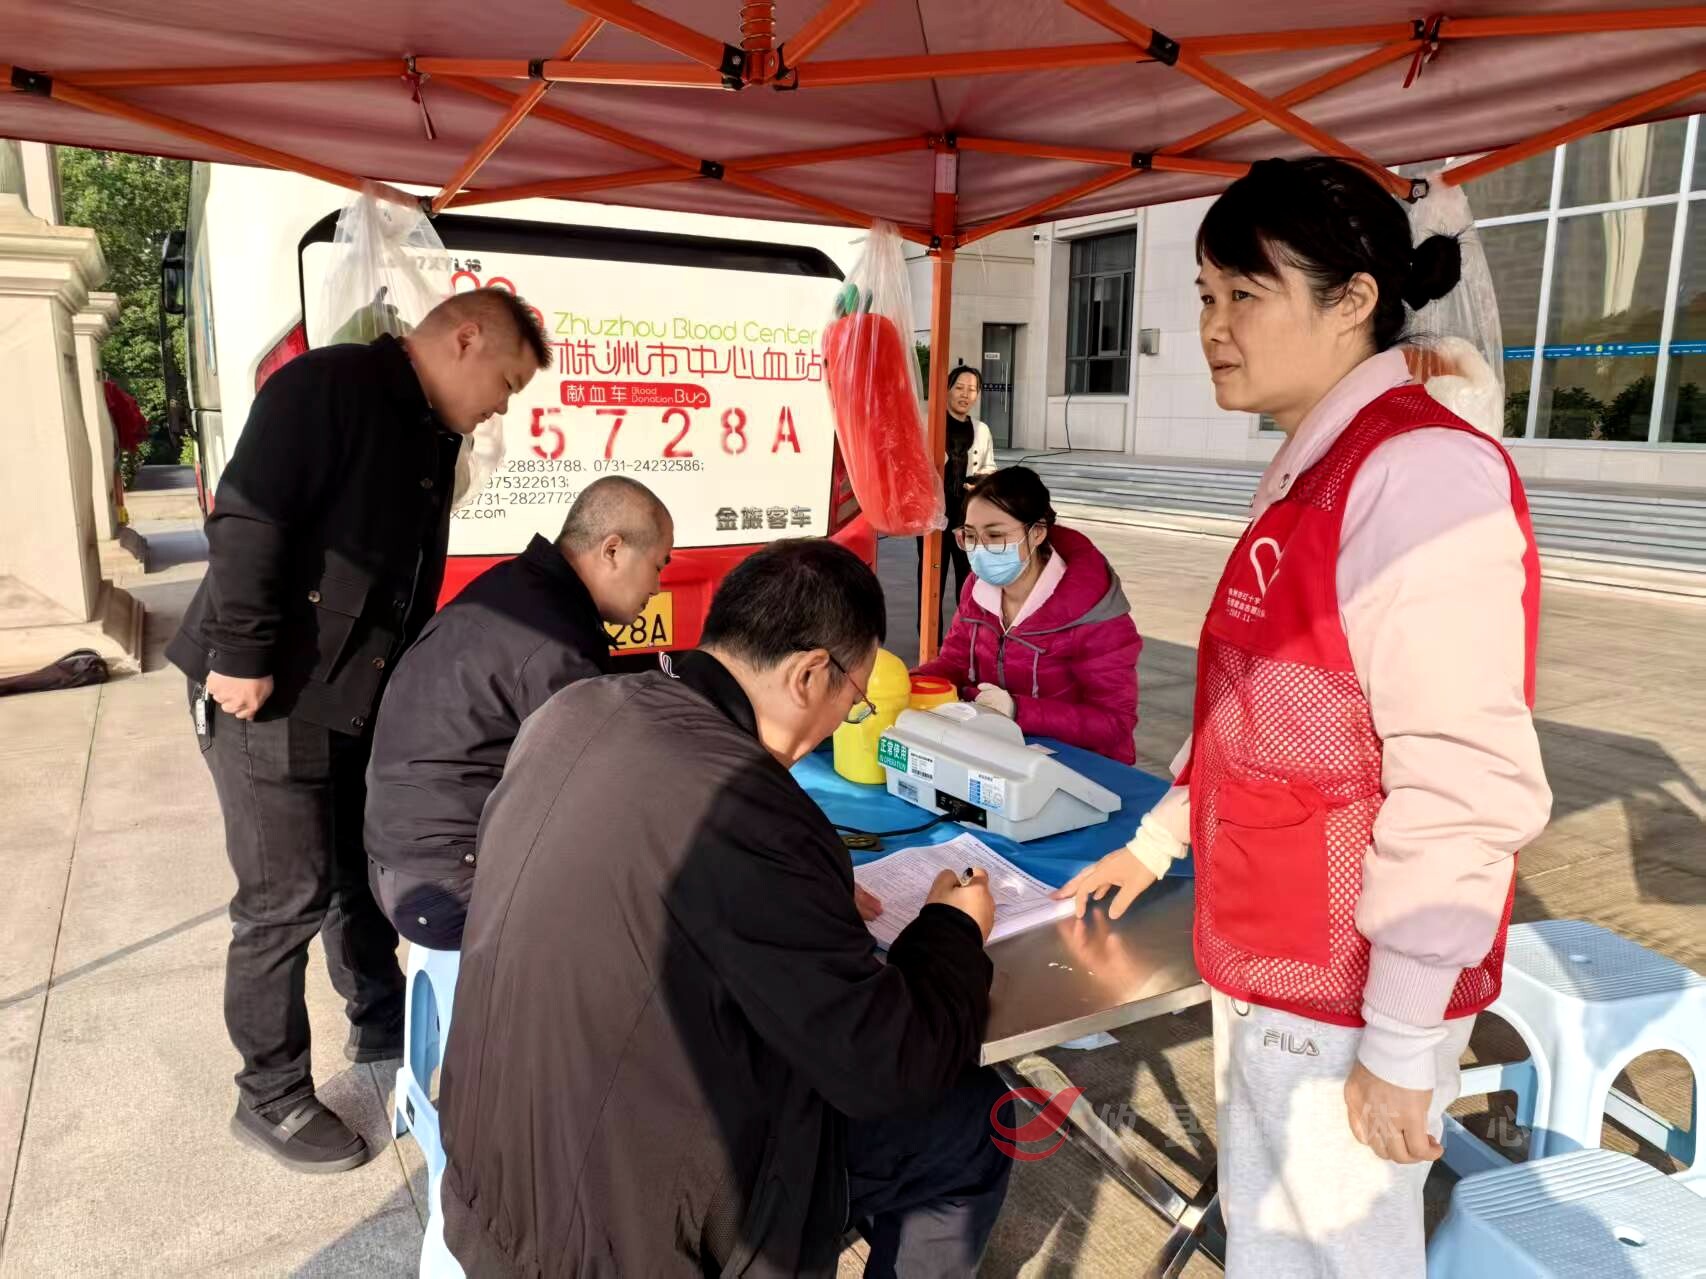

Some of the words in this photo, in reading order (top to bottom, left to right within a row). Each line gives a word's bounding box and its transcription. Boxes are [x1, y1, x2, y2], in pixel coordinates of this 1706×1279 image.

[554, 311, 666, 338] Zhuzhou
[673, 317, 737, 341] Blood
[743, 320, 818, 345] Center
[546, 338, 822, 381] 株洲市中心血站
[567, 384, 627, 403] 献血车
[631, 386, 657, 395] Blood
[468, 491, 578, 505] 731-2822772
[880, 738, 907, 762] 正常使用
[1263, 1029, 1320, 1056] FILA
